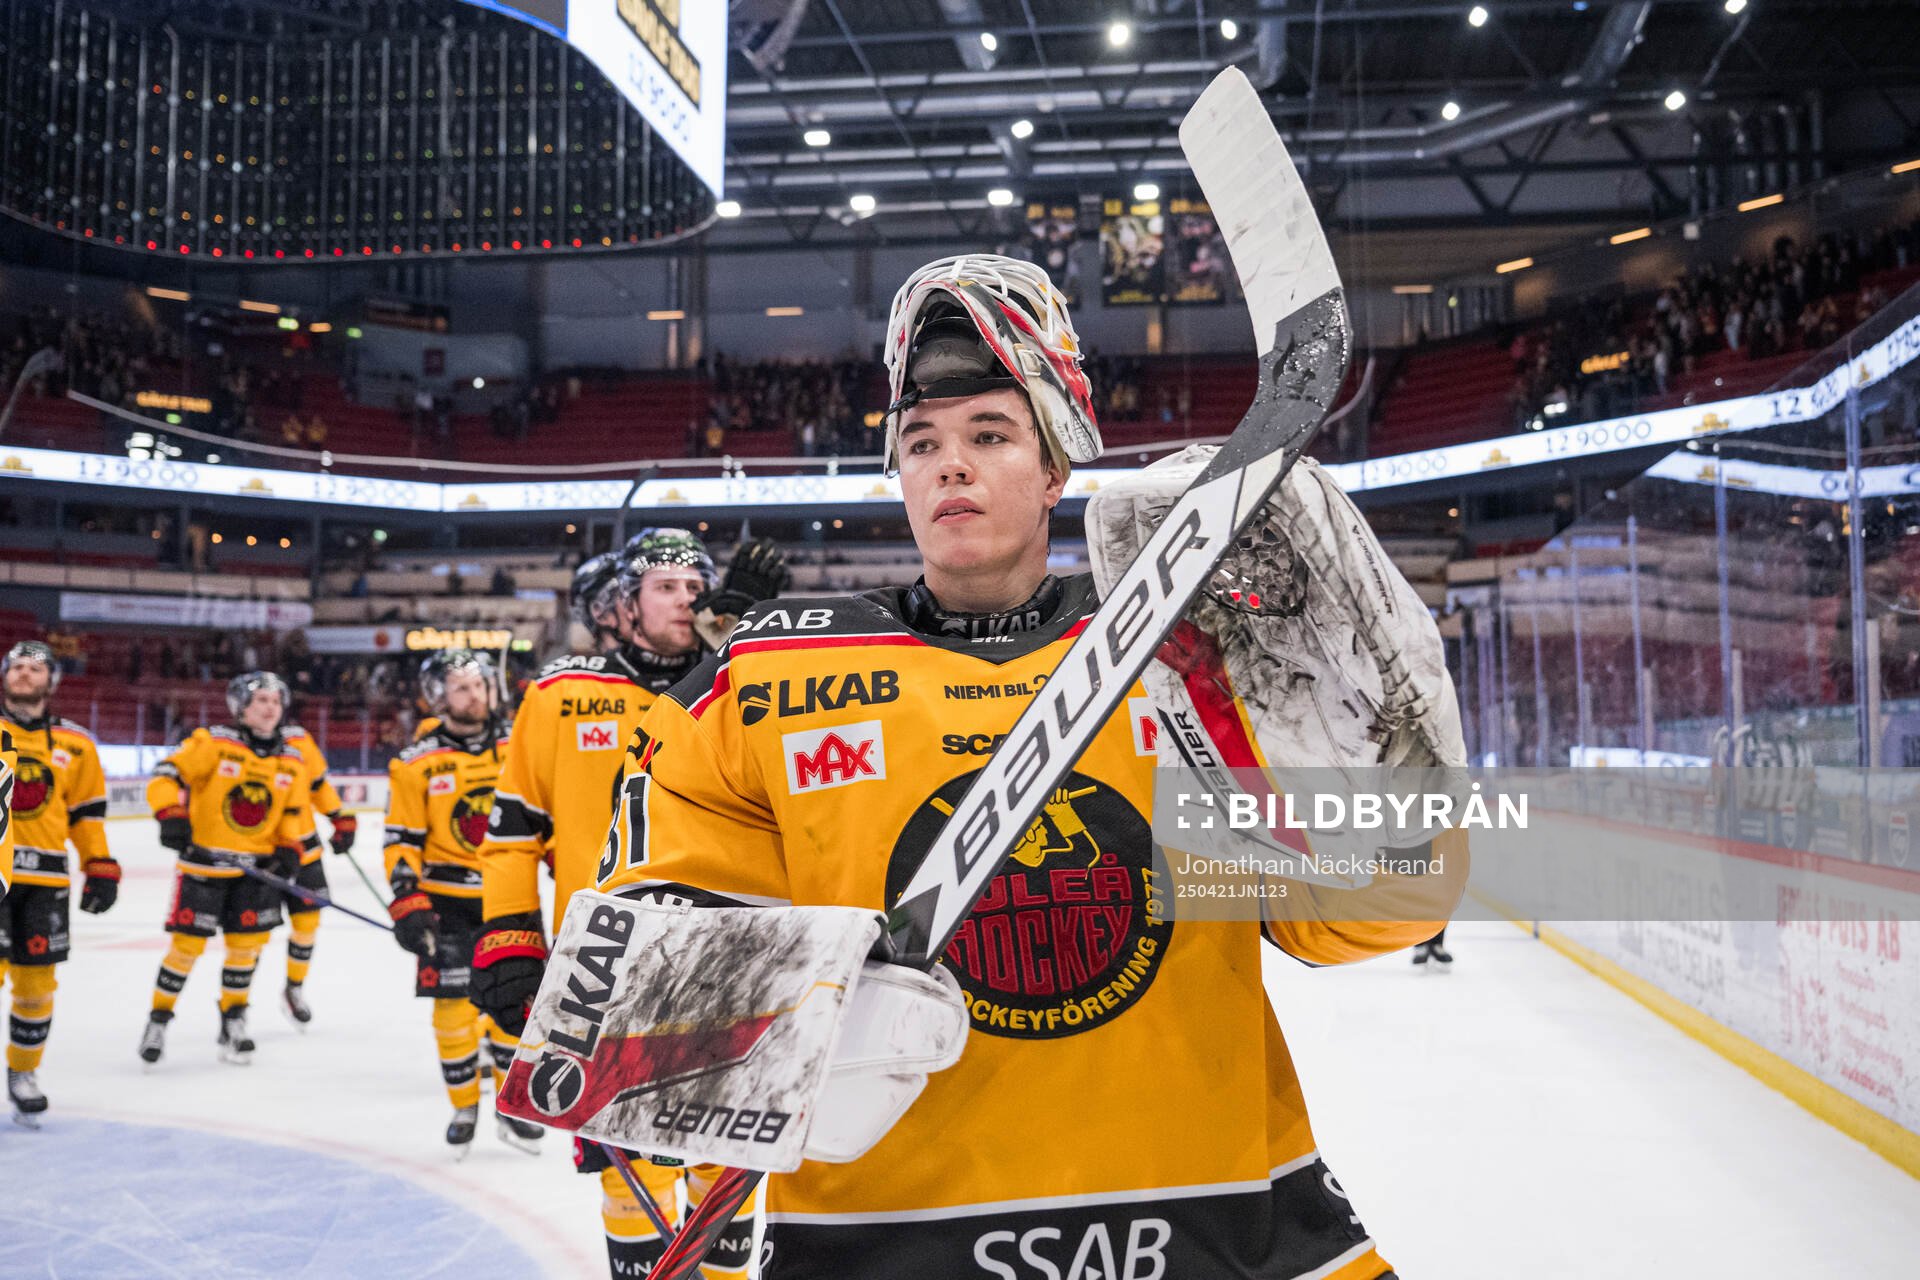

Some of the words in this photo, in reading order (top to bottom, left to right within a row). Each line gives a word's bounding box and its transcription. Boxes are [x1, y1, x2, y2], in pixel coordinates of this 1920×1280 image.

[726, 609, 834, 646] SAB
[577, 698, 626, 716] LKAB
[779, 669, 900, 718] LKAB
[944, 685, 1001, 699] NIEMI
[1004, 683, 1033, 697] BIL
[953, 508, 1210, 886] BAUER
[793, 732, 876, 789] MAX
[973, 853, 1132, 913] ULEÅ
[1141, 867, 1164, 927] 1977
[548, 903, 636, 1059] LKAB
[961, 936, 1158, 1031] OCKEYFÖRENING
[652, 1100, 792, 1144] BAUER
[973, 1218, 1172, 1280] SSAB
